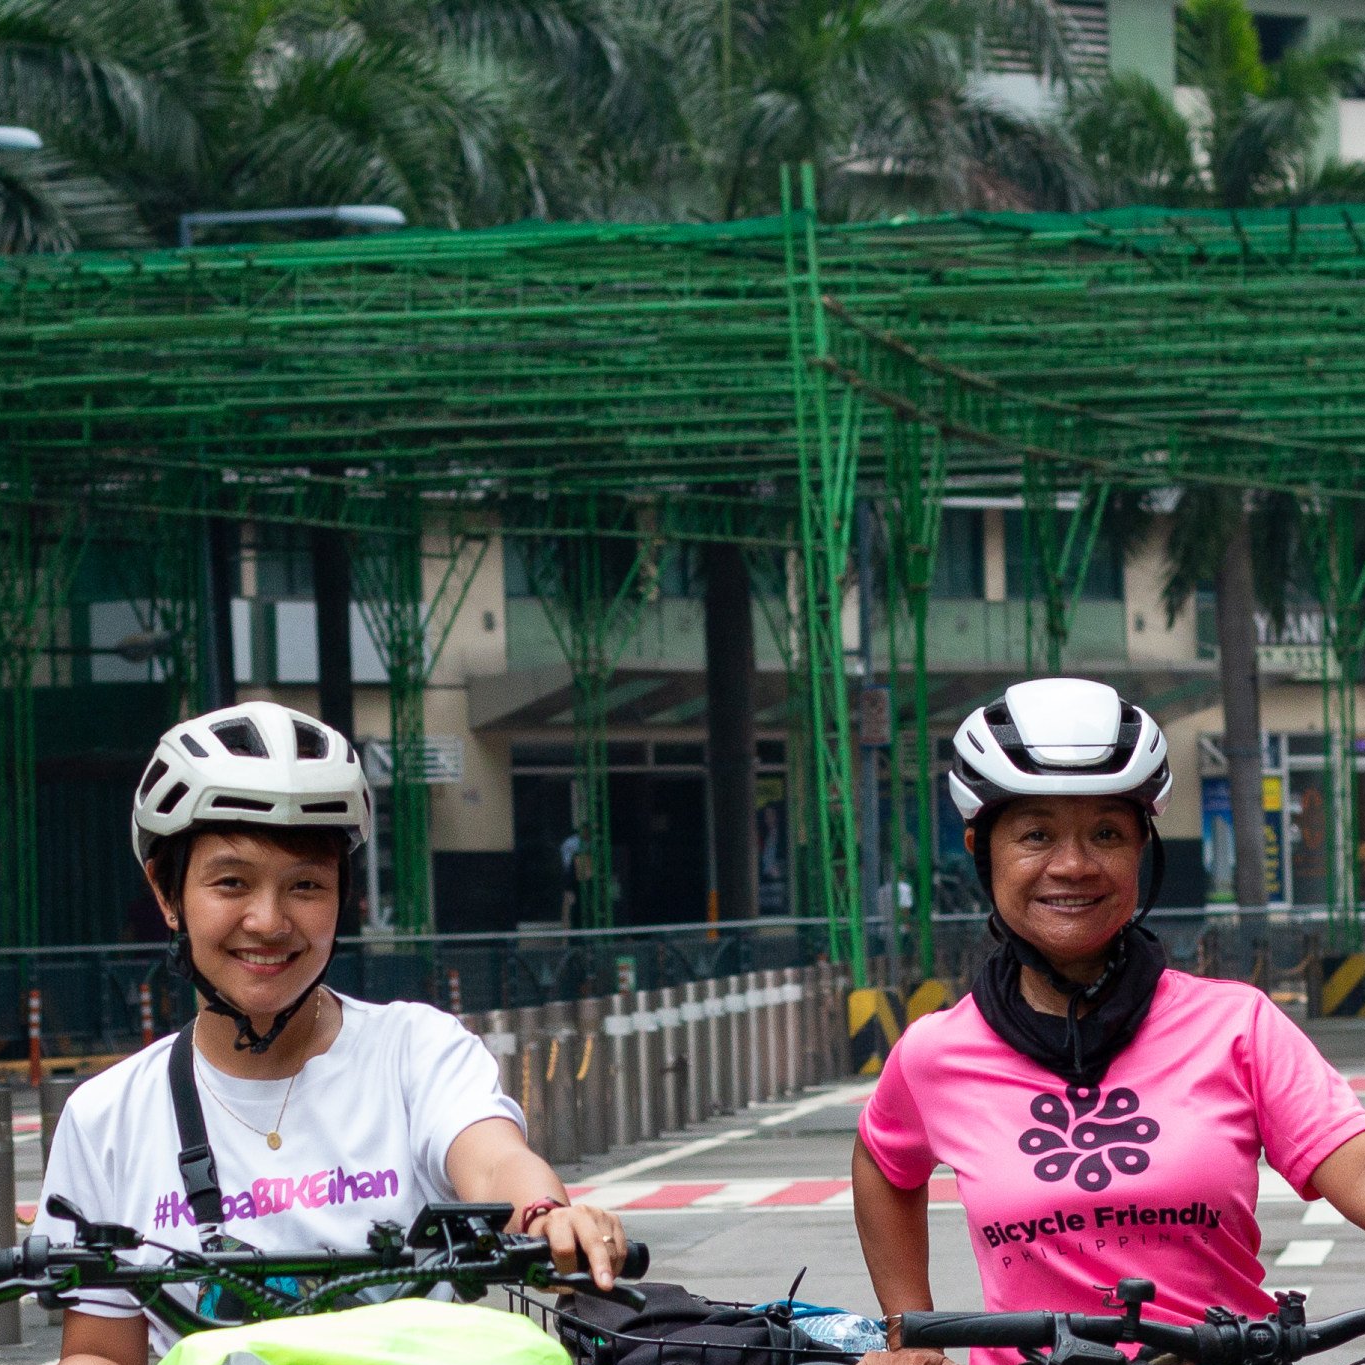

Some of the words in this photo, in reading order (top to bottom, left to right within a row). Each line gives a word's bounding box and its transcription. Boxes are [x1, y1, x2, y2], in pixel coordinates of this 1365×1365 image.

[982, 1209, 1086, 1248] Bicycle
[1093, 1202, 1222, 1229] Friendly
[1001, 1232, 1210, 1270] PHILIPPINES
